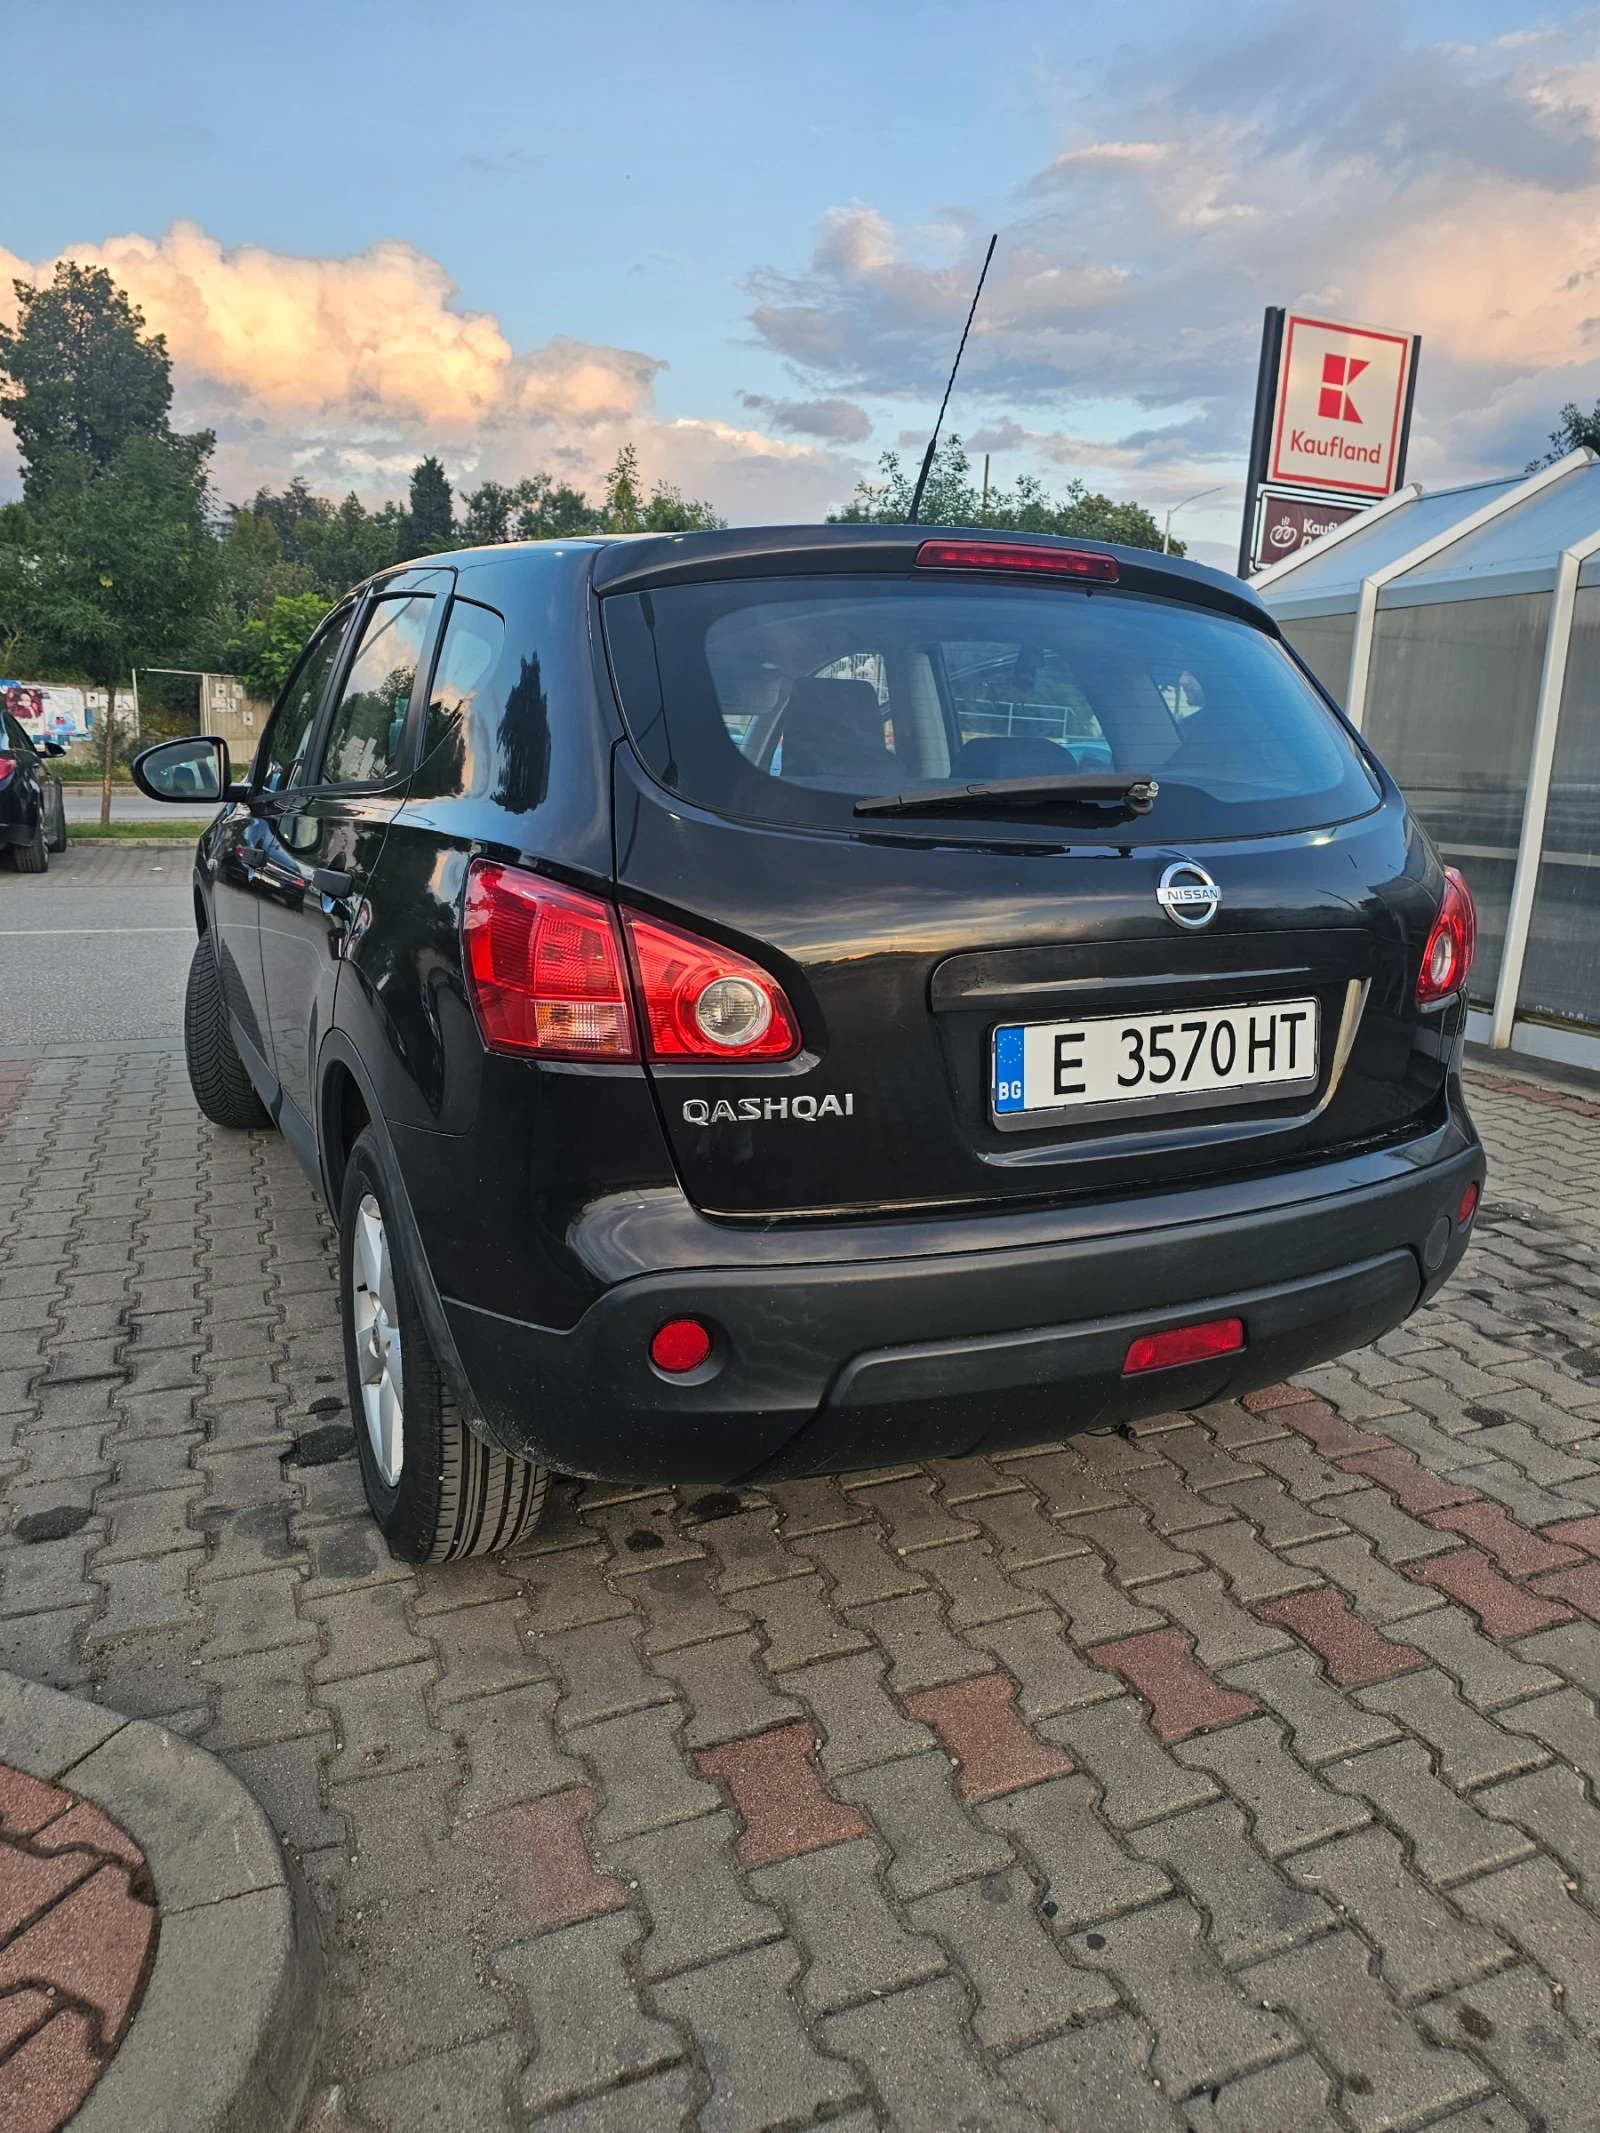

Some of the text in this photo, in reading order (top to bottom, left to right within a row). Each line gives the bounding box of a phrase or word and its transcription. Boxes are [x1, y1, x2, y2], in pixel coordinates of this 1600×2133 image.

[1317, 353, 1371, 425] K
[1290, 429, 1382, 464] Kaufland
[1167, 889, 1218, 900] NISSAN
[1054, 1011, 1307, 1096] E 3570 HT
[998, 1080, 1022, 1100] BG
[682, 1093, 854, 1126] QASHQAI
